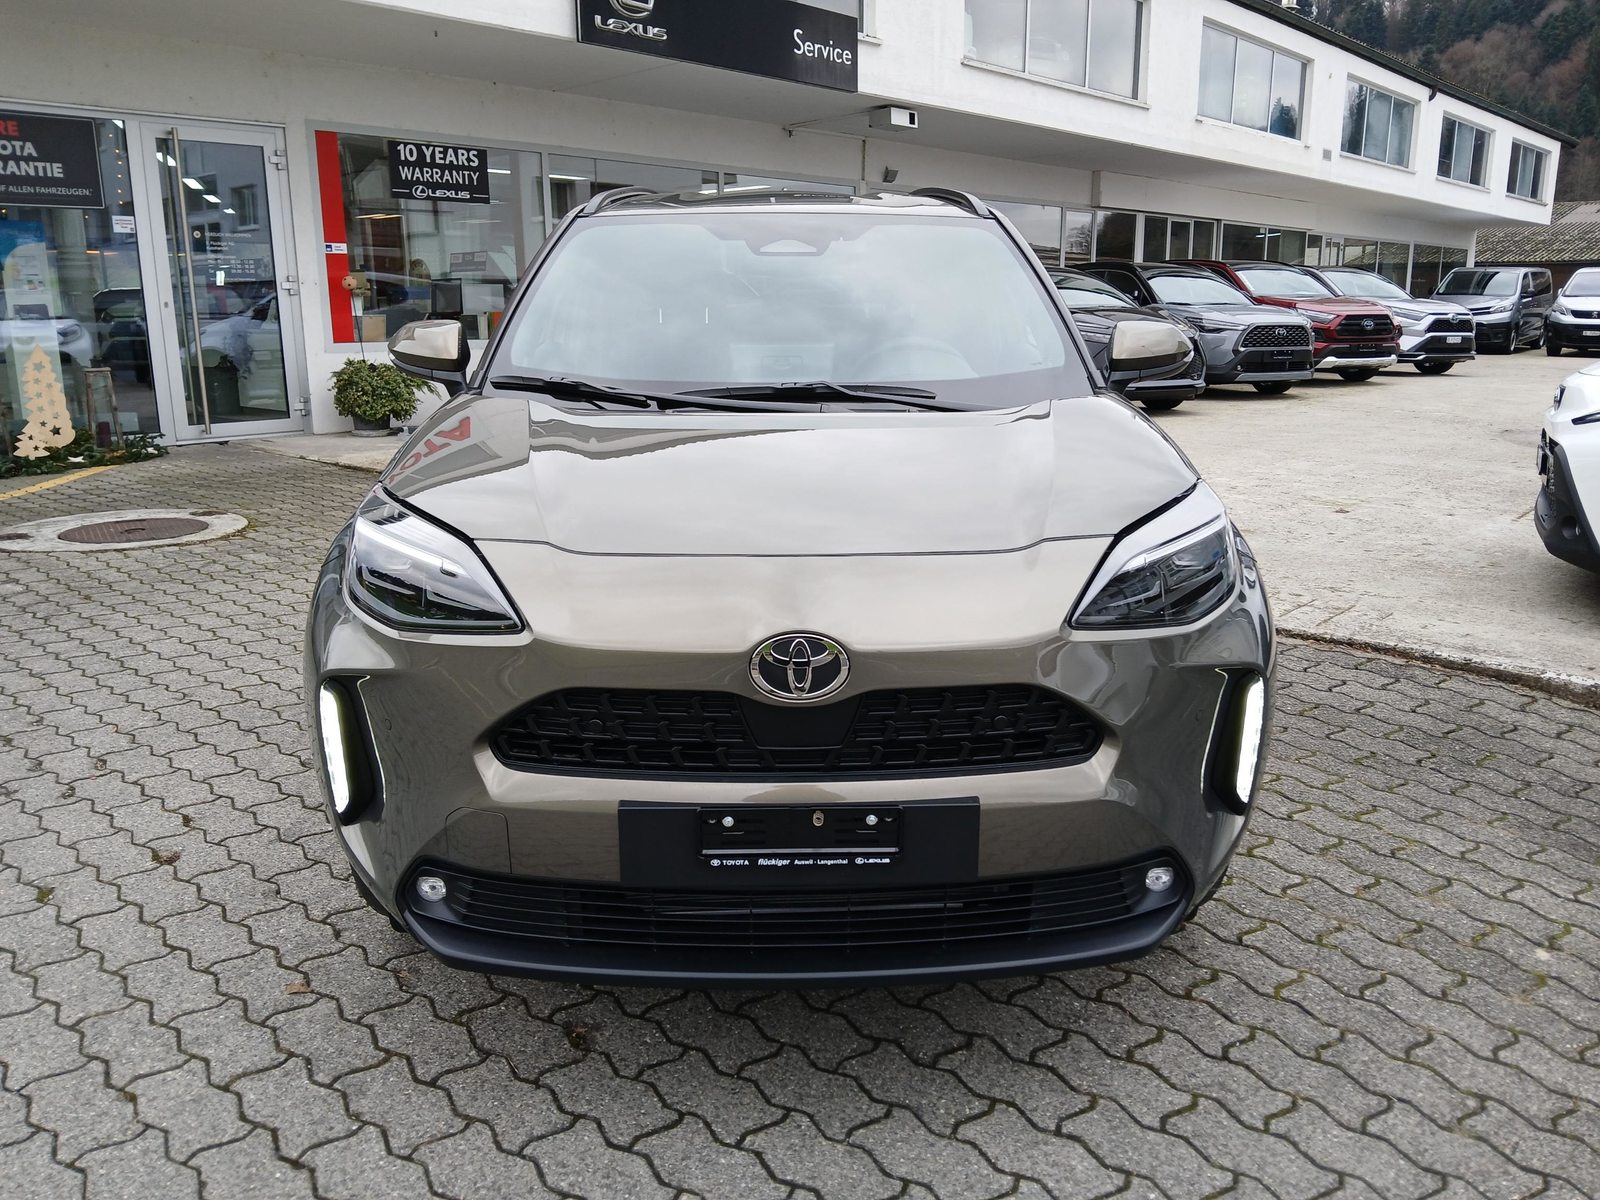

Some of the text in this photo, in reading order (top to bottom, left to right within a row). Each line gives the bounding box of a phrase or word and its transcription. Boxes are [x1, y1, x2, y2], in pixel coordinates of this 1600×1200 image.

[594, 15, 668, 41] LEXUS
[793, 28, 852, 65] Service
[397, 143, 480, 167] 10 YEARS
[398, 165, 480, 186] WARRANTY
[8, 185, 34, 194] ALLEN
[428, 188, 471, 199] LEXUS
[817, 858, 848, 866] Langenthal
